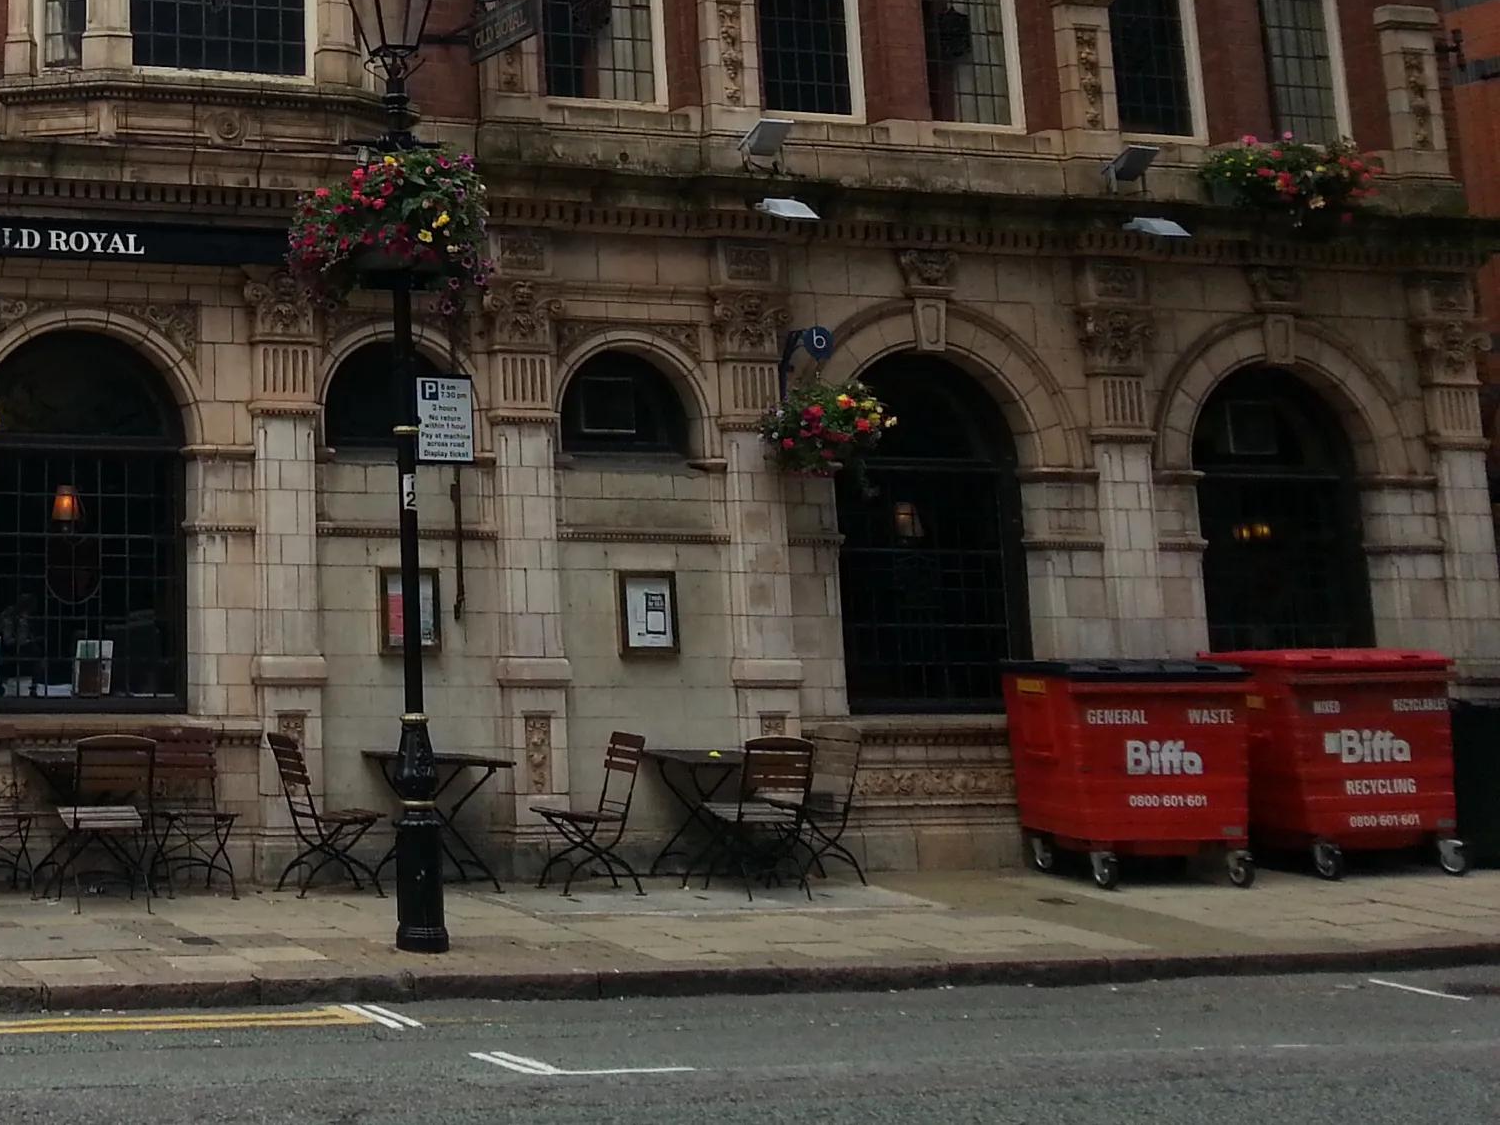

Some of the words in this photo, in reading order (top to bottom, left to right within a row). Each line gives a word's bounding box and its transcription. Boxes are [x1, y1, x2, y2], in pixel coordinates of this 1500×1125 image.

[48, 229, 145, 255] ROYAL
[1087, 709, 1149, 725] GENERAL
[1188, 708, 1235, 724] WASTE
[1313, 700, 1341, 714] MIXED
[1392, 698, 1449, 712] RECYCLABLES
[1126, 739, 1204, 775] Biffa
[1340, 729, 1412, 763] Biffa
[1345, 778, 1417, 796] RECYCLING
